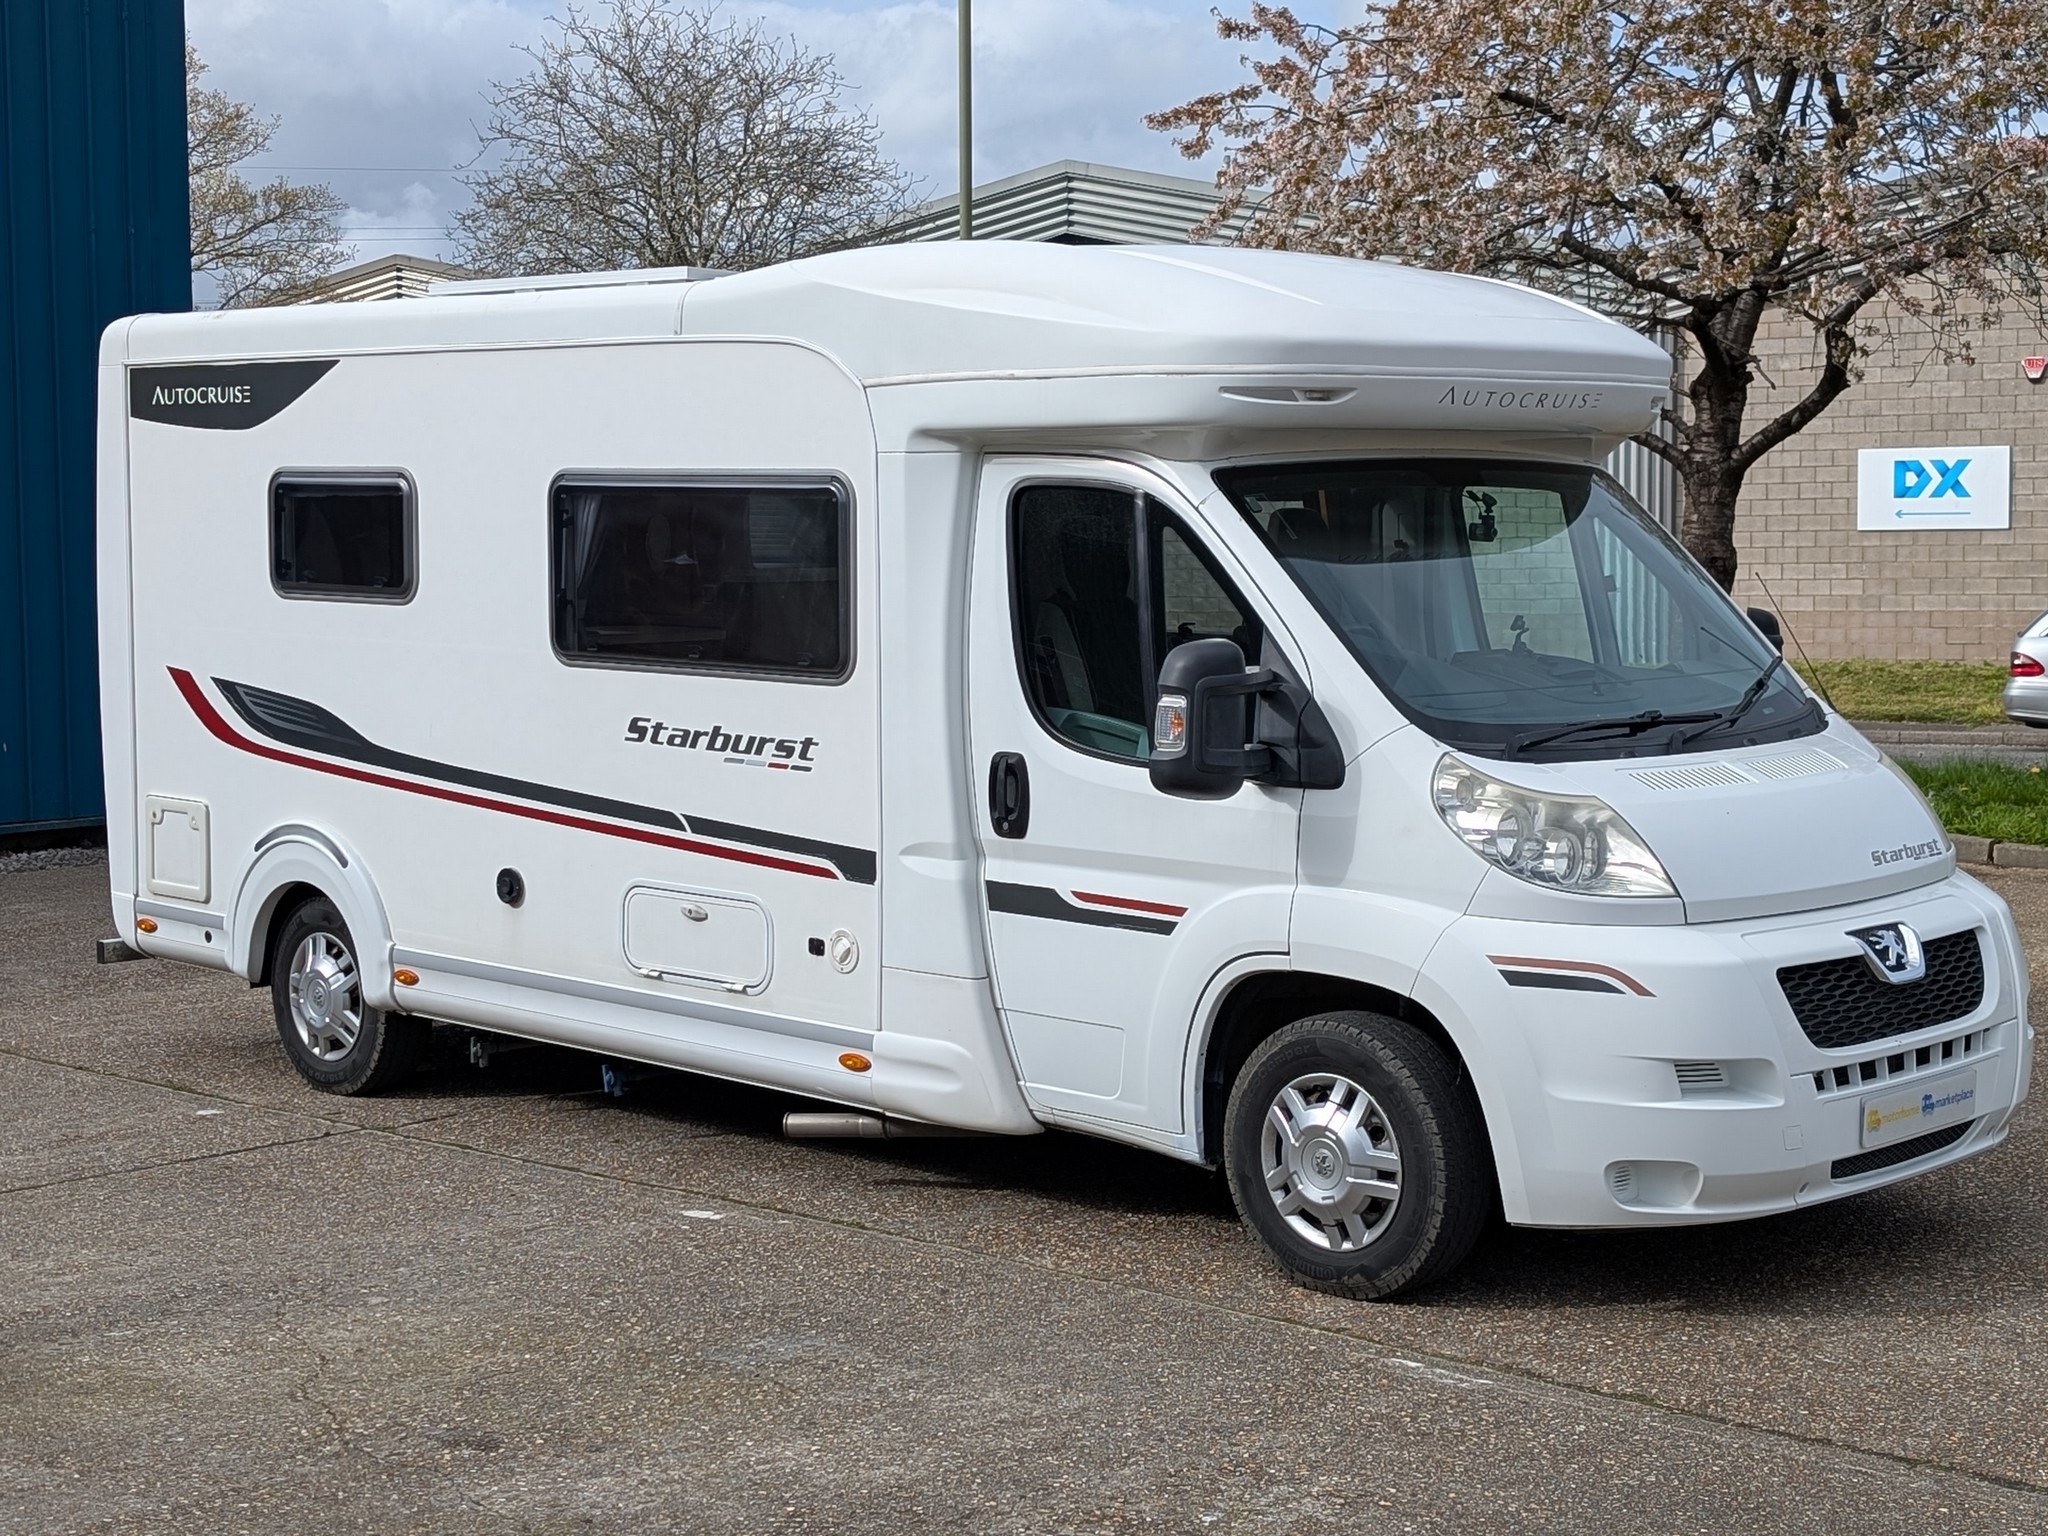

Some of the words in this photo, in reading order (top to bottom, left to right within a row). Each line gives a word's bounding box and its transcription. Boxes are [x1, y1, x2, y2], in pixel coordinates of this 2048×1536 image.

[152, 385, 251, 405] AUTOCRUISE
[1438, 385, 1603, 409] AUTOCRUISE
[1893, 458, 1973, 499] DX
[624, 716, 819, 762] Starburst
[1871, 838, 1941, 867] Starburst
[1934, 1089, 1974, 1109] marketplace
